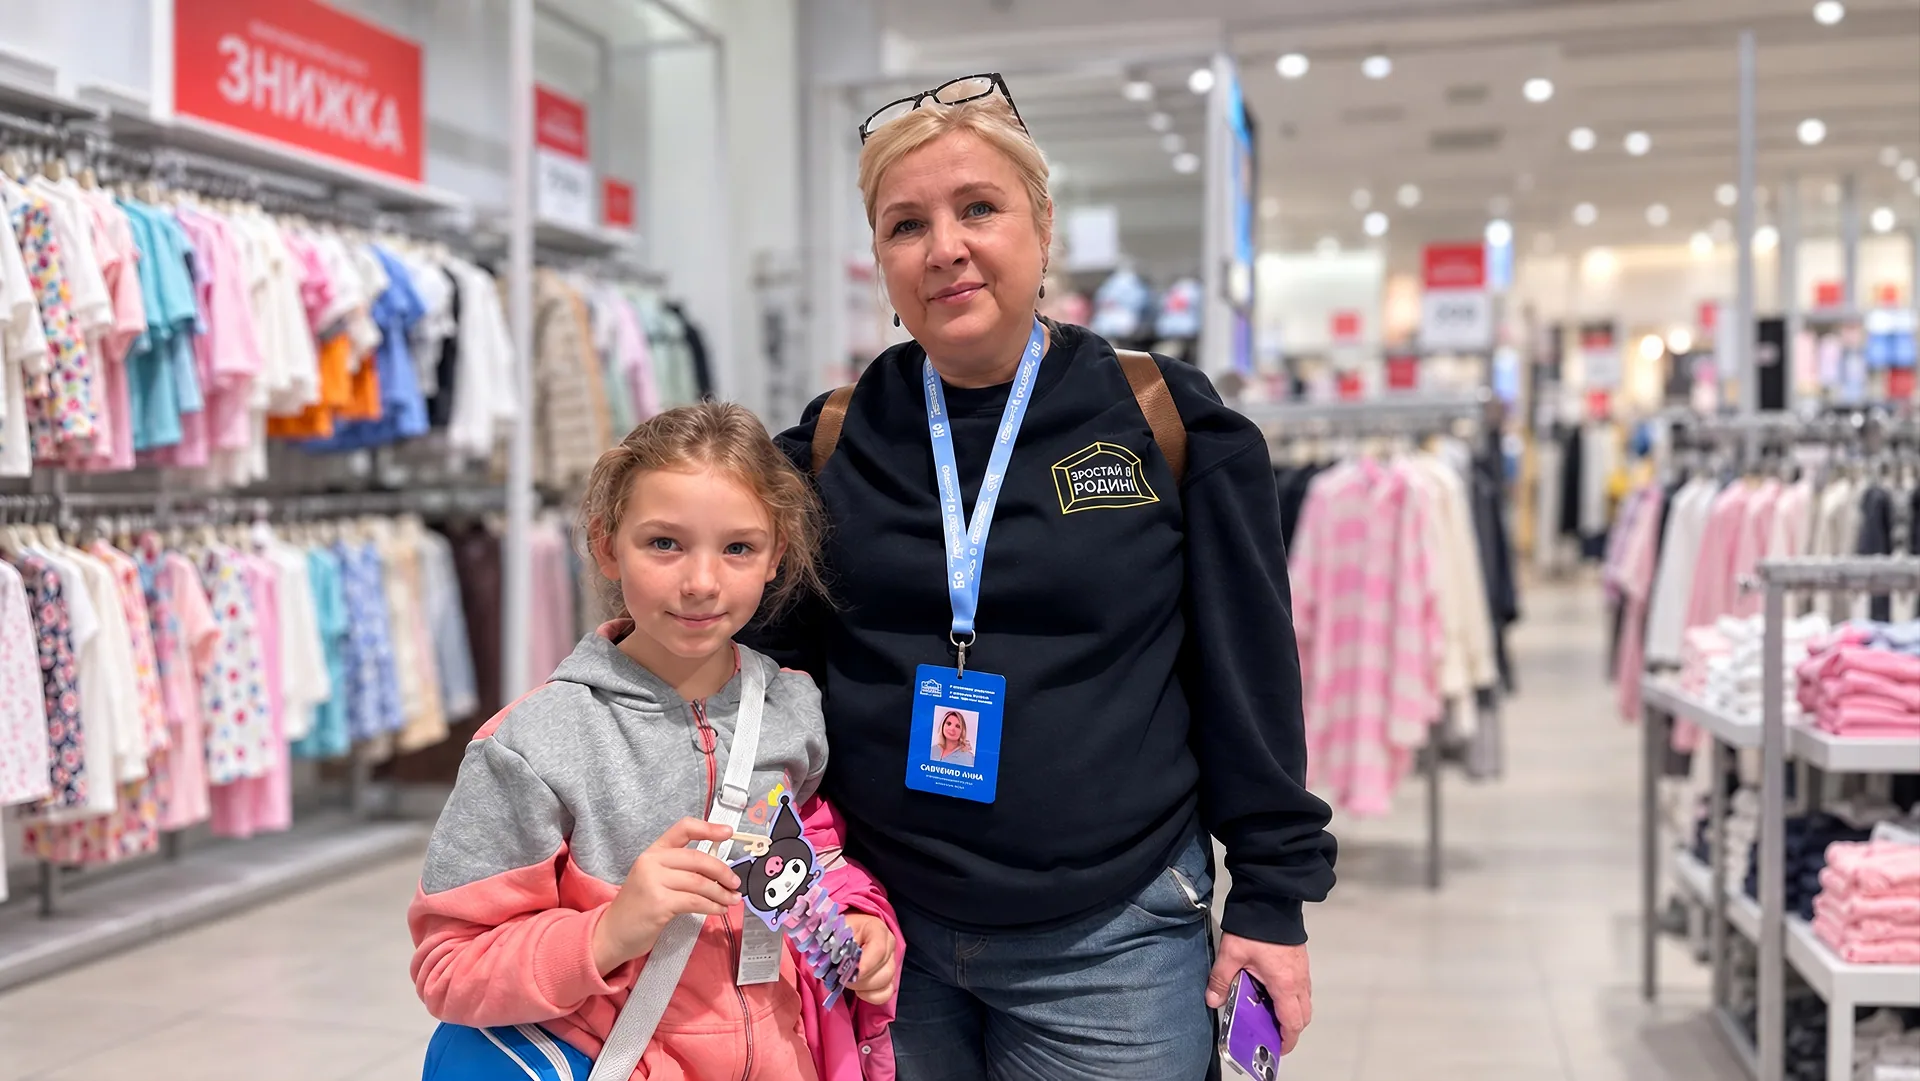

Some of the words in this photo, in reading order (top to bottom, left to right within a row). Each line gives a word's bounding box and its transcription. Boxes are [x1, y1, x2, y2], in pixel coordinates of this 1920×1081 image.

[217, 35, 406, 156] ЗНИЖКА
[1071, 463, 1123, 481] ЗРОСТАЙ
[1073, 479, 1135, 495] РОДИНІ
